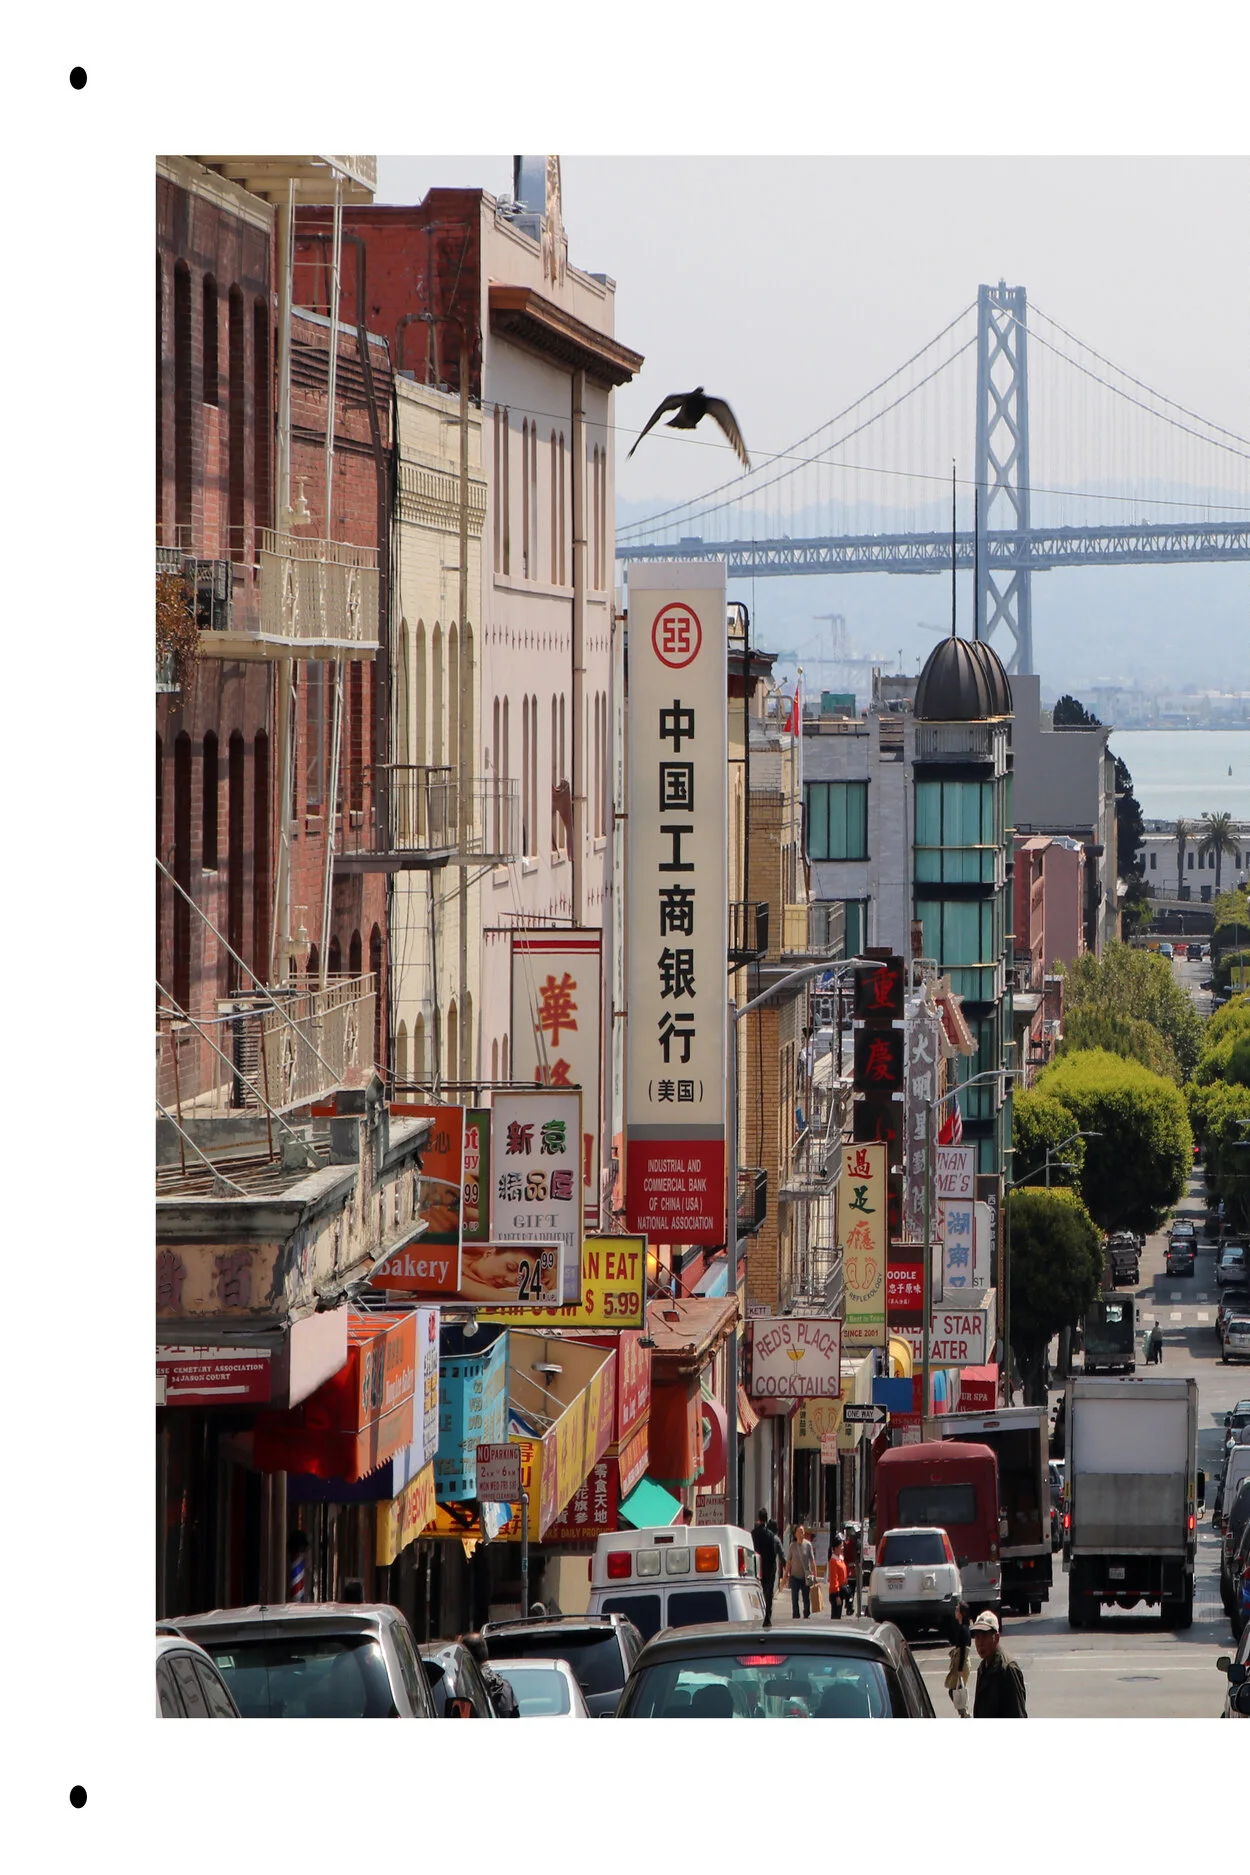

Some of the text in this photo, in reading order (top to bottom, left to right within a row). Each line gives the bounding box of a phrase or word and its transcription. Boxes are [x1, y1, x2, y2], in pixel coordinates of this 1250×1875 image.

[658, 699, 697, 1065] 中国工商银行
[505, 1119, 567, 1155] 新意
[648, 1159, 702, 1173] INDUSTRIAL AND
[498, 1169, 575, 1202] 精品屋
[644, 1178, 707, 1192] COMMERCIAL BANK
[649, 1197, 658, 1211] OF
[660, 1197, 681, 1211] CHINA
[846, 1148, 877, 1250] 過足癮
[513, 1214, 560, 1229] GIFT
[637, 1216, 714, 1230] NATIONAL ASSOCIATION
[379, 1255, 450, 1284] Bakery
[605, 1252, 639, 1280] EAT
[887, 1270, 917, 1280] OODLE
[849, 1272, 883, 1303] REFLEXOLOGY
[604, 1292, 640, 1316] 5.99
[843, 1329, 863, 1338] SINCE
[943, 1315, 982, 1336] STAR
[755, 1322, 837, 1361] RED'S PLACE
[908, 1340, 968, 1360] HATER
[215, 1364, 264, 1372] ASSOCIATION
[755, 1375, 837, 1395] COCKTAILS
[847, 1409, 874, 1418] ONE WAY
[478, 1446, 519, 1461] NO PARKING
[594, 1463, 608, 1524] 零食天地
[561, 1528, 581, 1538] DAILY
